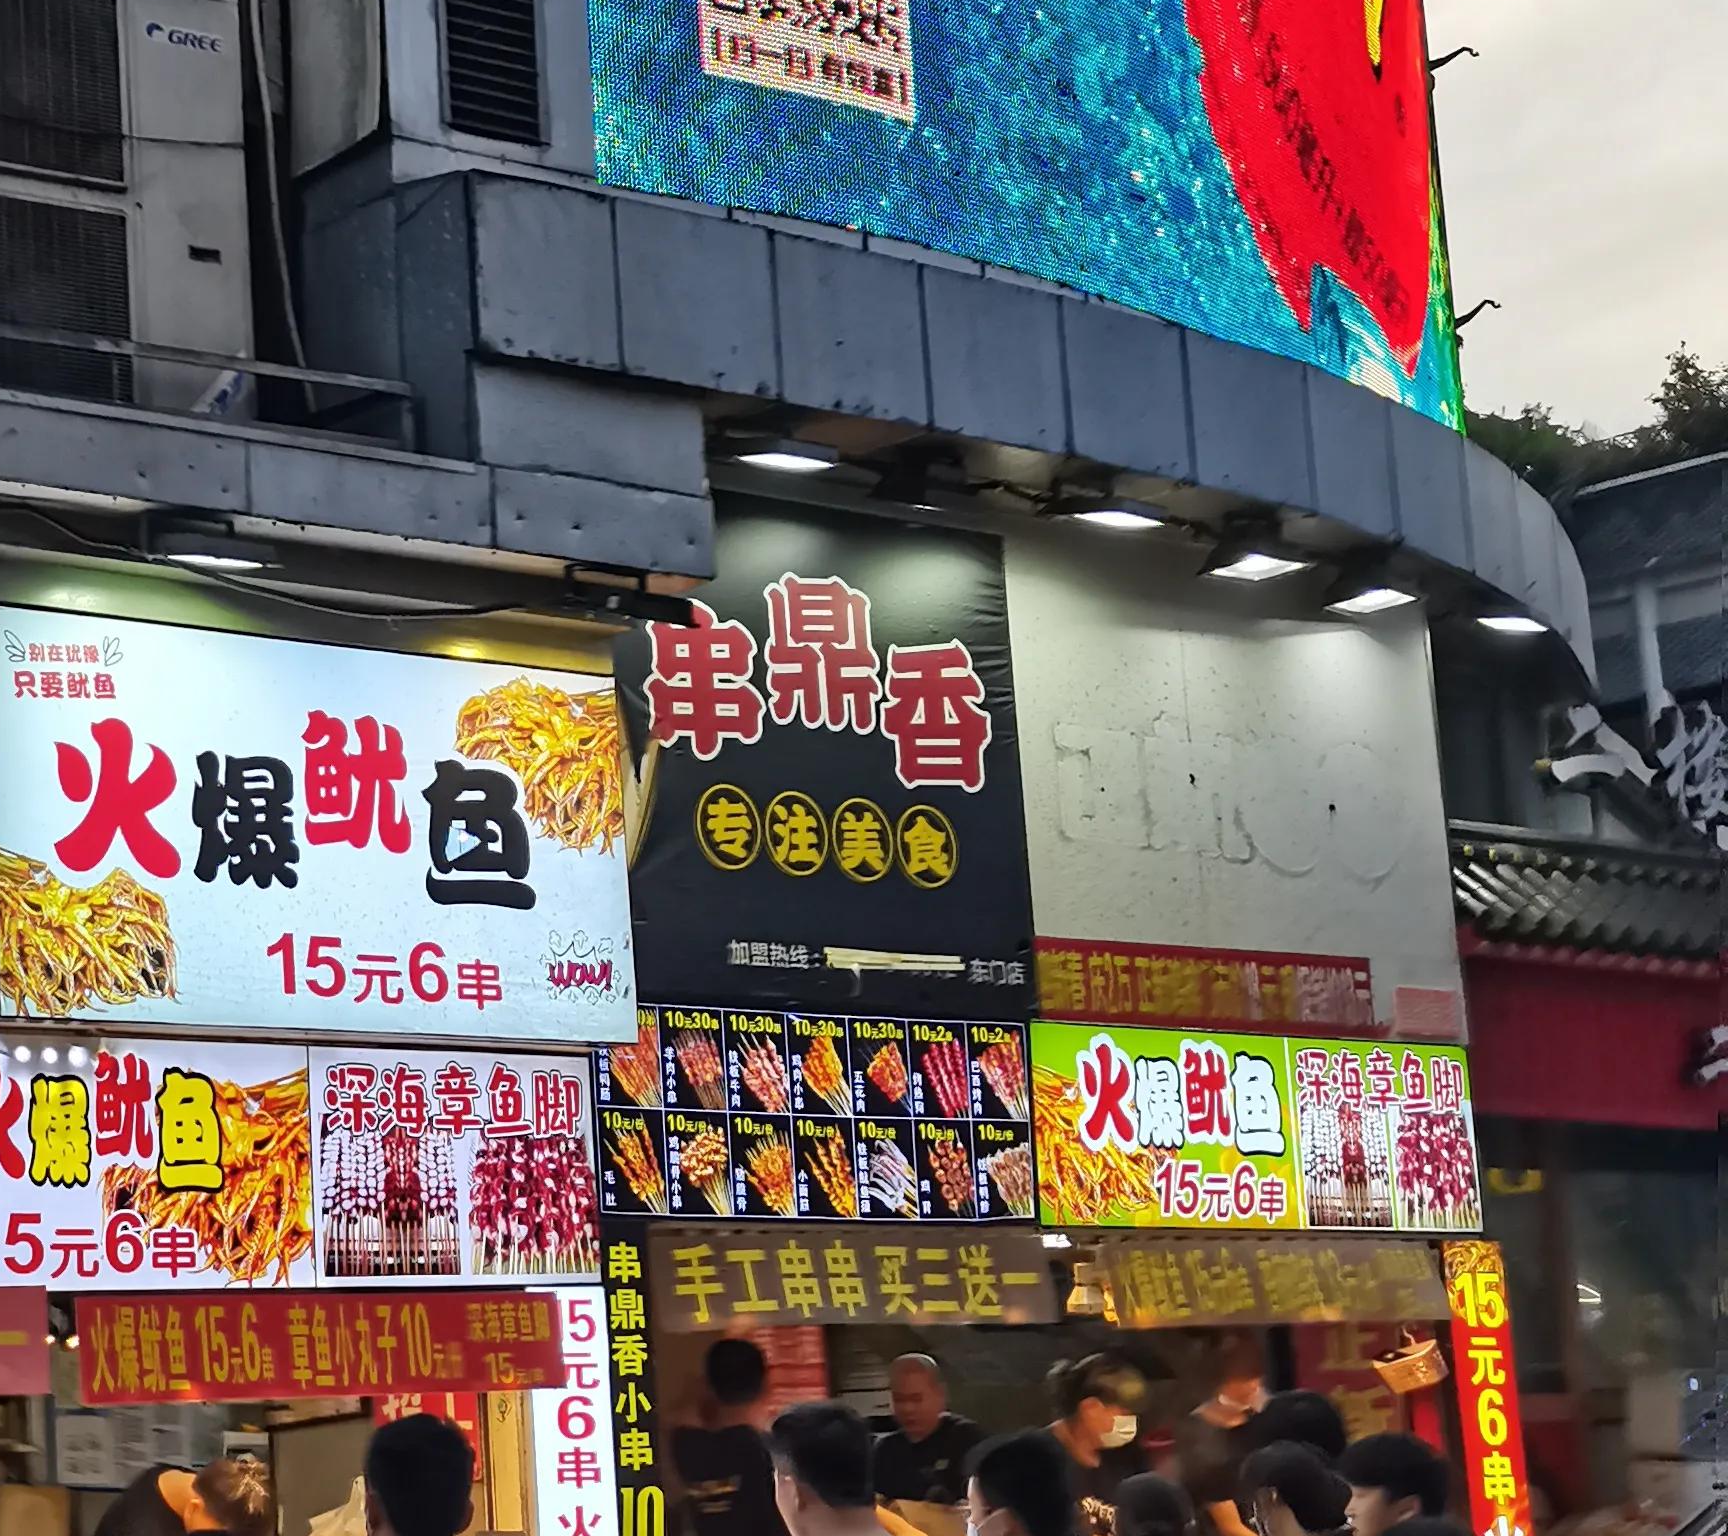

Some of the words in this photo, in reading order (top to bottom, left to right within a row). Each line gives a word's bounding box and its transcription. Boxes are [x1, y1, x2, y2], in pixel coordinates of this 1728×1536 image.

[167, 28, 222, 53] GREE
[13, 670, 118, 701] 只要鱿鱼
[644, 571, 992, 793] 串鼎香
[53, 709, 536, 911] 火爆鱿鱼
[704, 796, 952, 879] 专注美食
[266, 932, 504, 1012] 15元6串
[323, 1062, 582, 1141] 深海章鱼脚
[1076, 1033, 1286, 1158] 火爆鱿鱼
[1294, 1047, 1463, 1115] 深海章鱼脚
[1152, 1158, 1288, 1224] 15元6串
[671, 1239, 1040, 1324] 手工串串买三送一
[90, 1303, 193, 1395] 火爆鱿鱼
[287, 1301, 399, 1390] 章鱼小丸子
